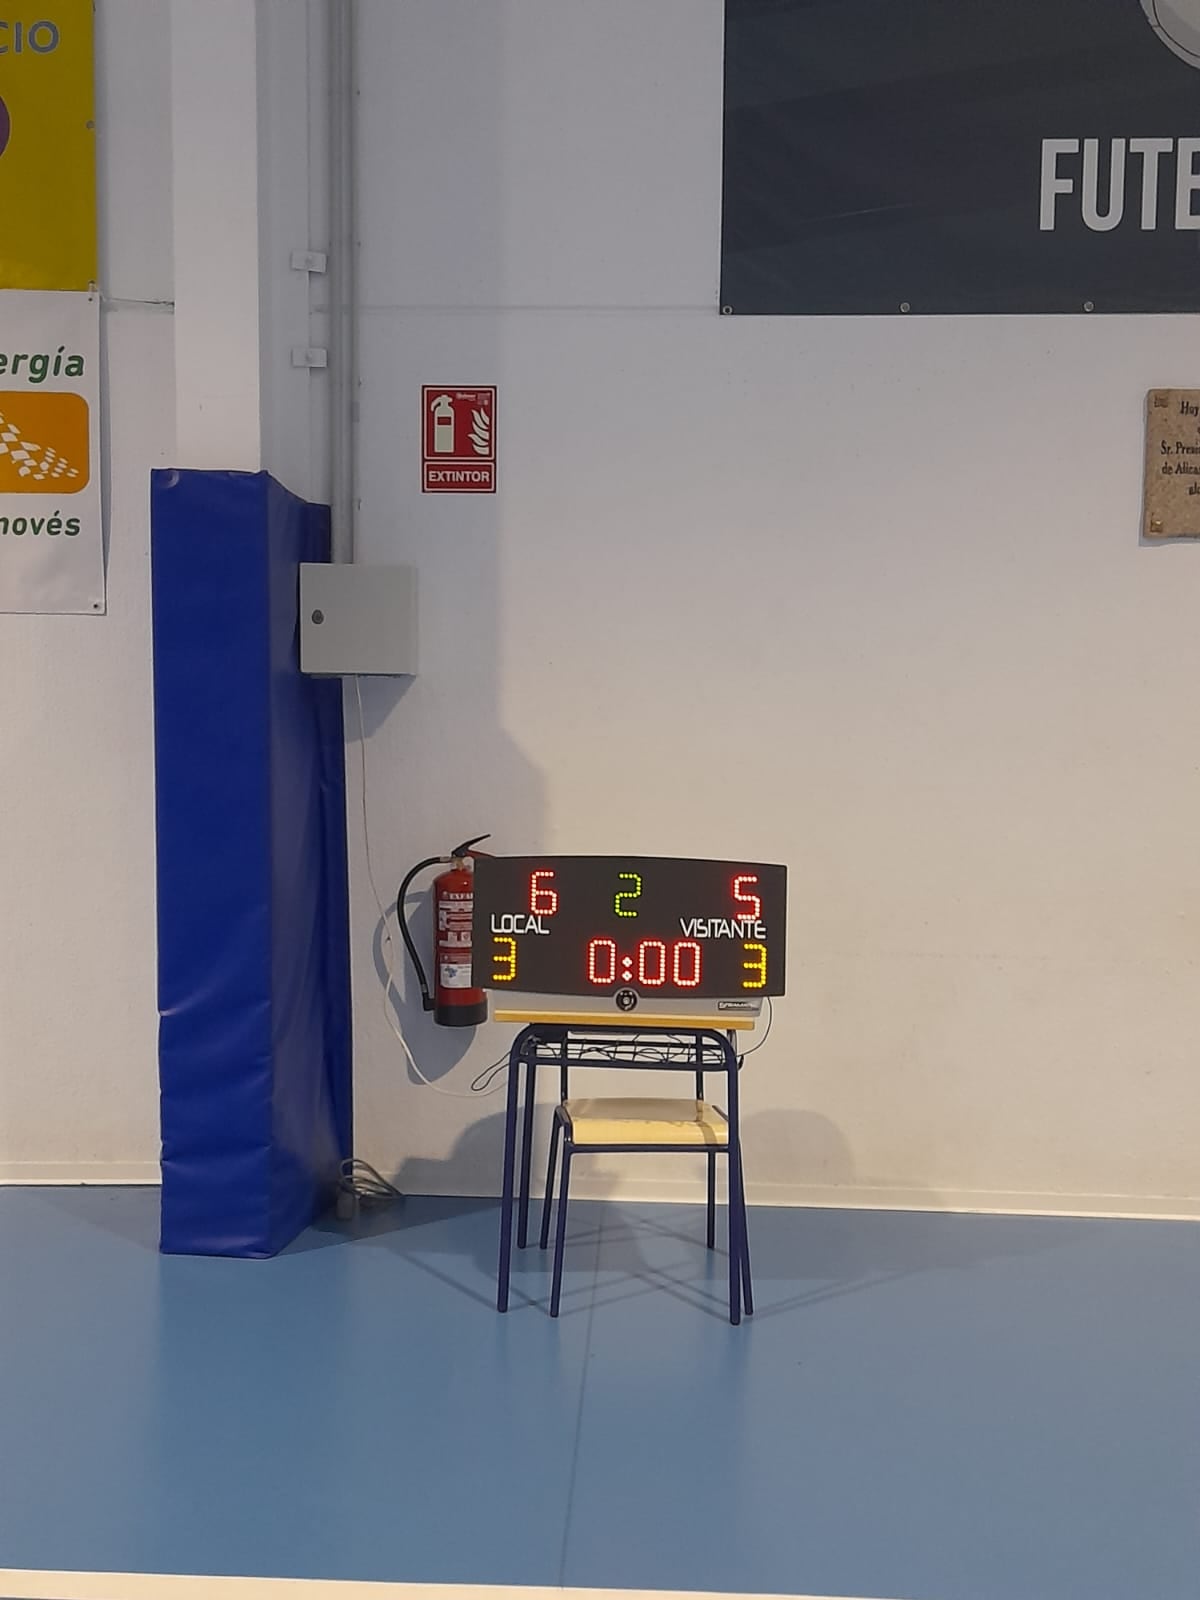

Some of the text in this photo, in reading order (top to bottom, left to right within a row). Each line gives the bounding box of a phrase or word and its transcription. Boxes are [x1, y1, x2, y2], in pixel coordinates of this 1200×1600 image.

[1040, 138, 1200, 231] FUTE
[428, 471, 490, 482] EXTINTOR
[1161, 462, 1200, 475] de Alica
[530, 871, 557, 915] 6
[614, 872, 642, 917] 2
[733, 875, 760, 921] 5
[490, 913, 550, 934] LOCAL
[679, 917, 767, 939] VISITANTE
[492, 936, 517, 981] 3
[588, 938, 701, 987] 0:00
[742, 942, 768, 989] 3
